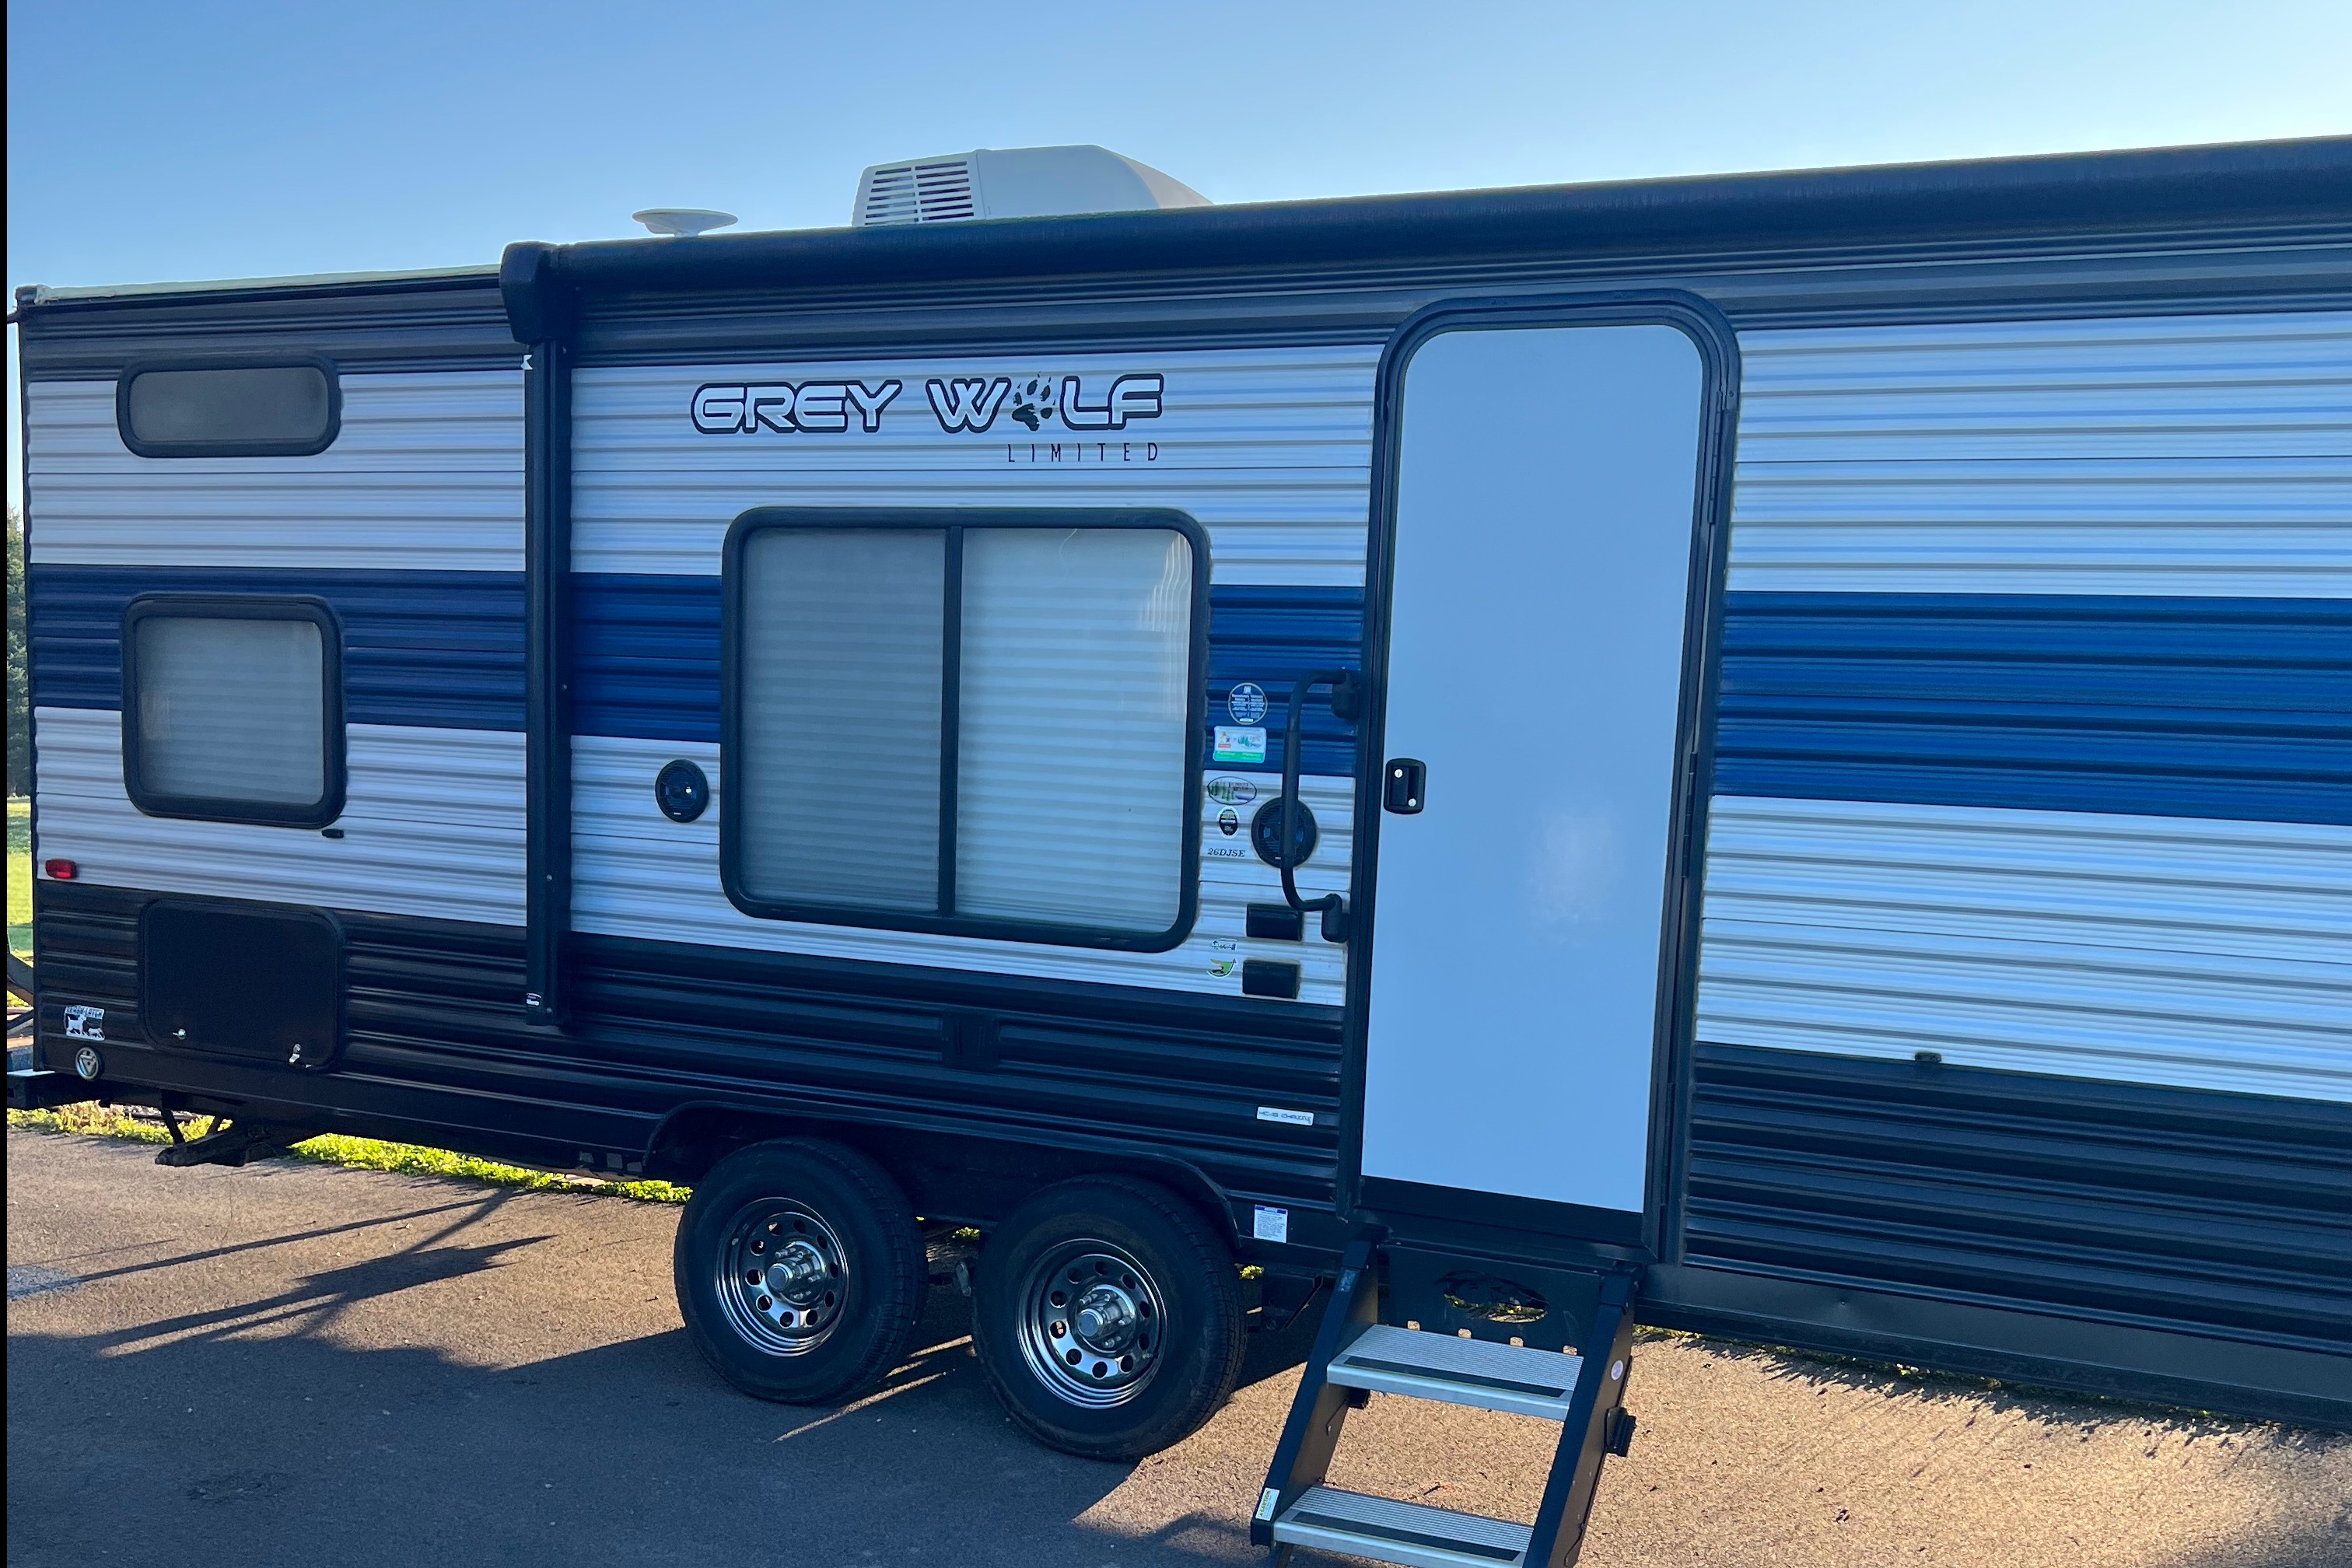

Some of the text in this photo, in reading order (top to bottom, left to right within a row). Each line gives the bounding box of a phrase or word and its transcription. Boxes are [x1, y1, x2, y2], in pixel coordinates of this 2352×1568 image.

[691, 380, 902, 433] GREY
[1008, 443, 1158, 463] LIMITED
[1207, 848, 1246, 858] 26DJSE
